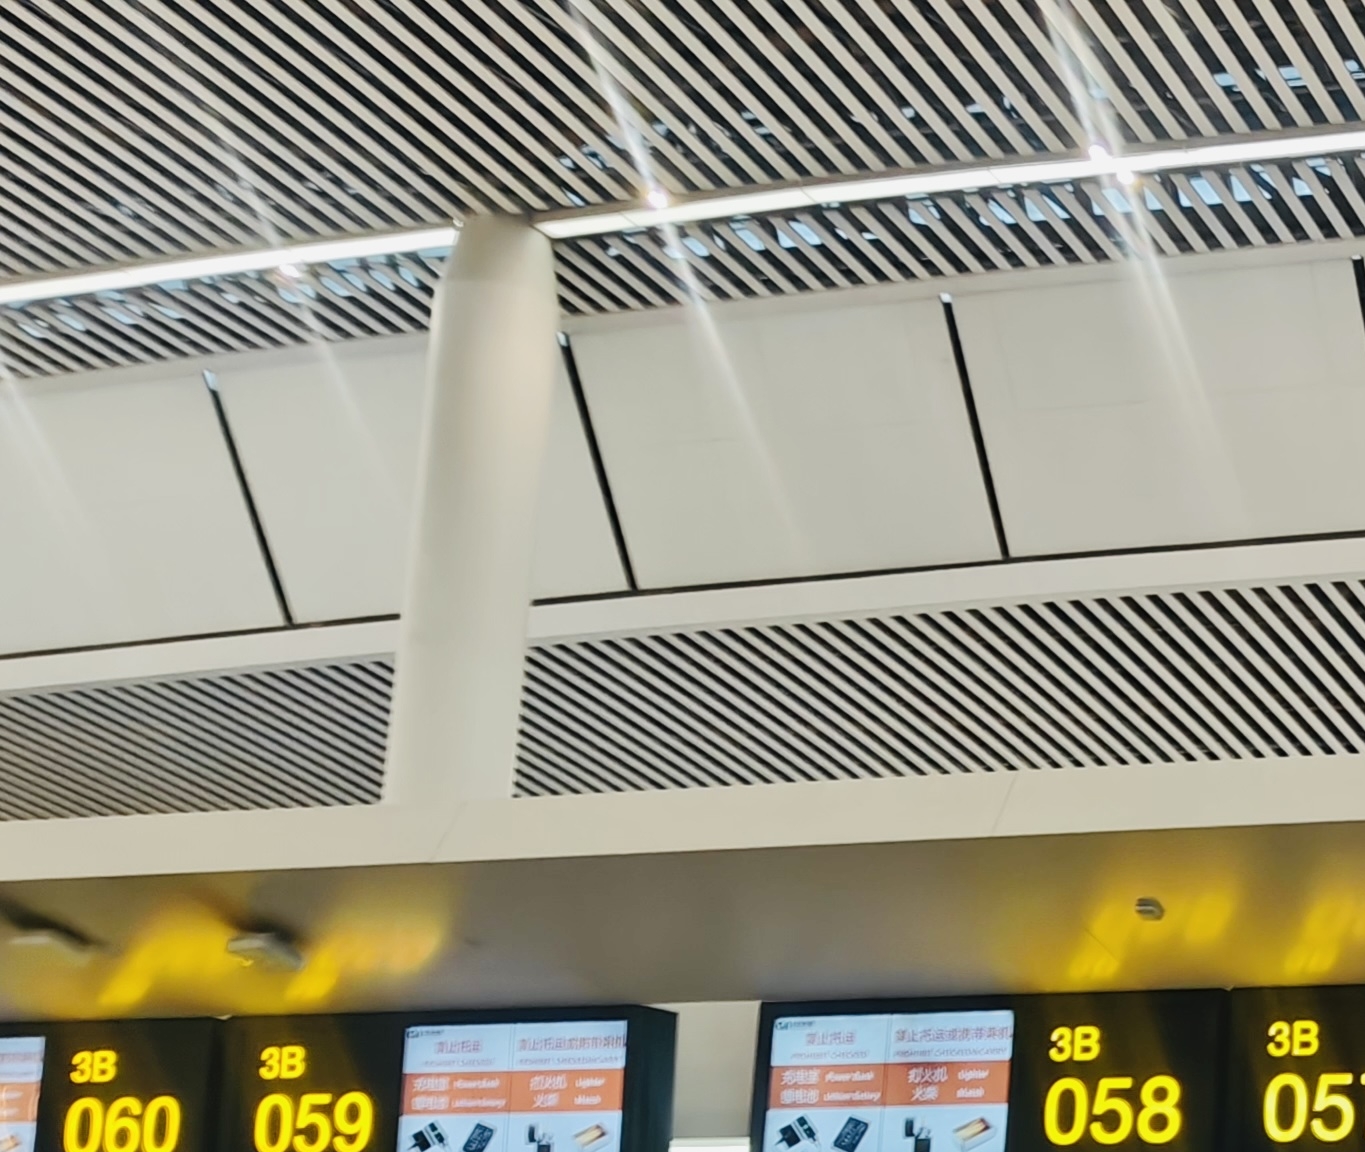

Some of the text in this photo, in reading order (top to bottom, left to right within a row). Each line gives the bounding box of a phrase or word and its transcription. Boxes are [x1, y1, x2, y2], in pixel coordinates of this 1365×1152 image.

[1048, 1025, 1100, 1062] 3B
[1267, 1020, 1319, 1056] 3B
[71, 1050, 117, 1083] 3B
[260, 1047, 304, 1080] 3B
[1044, 1075, 1182, 1146] 058
